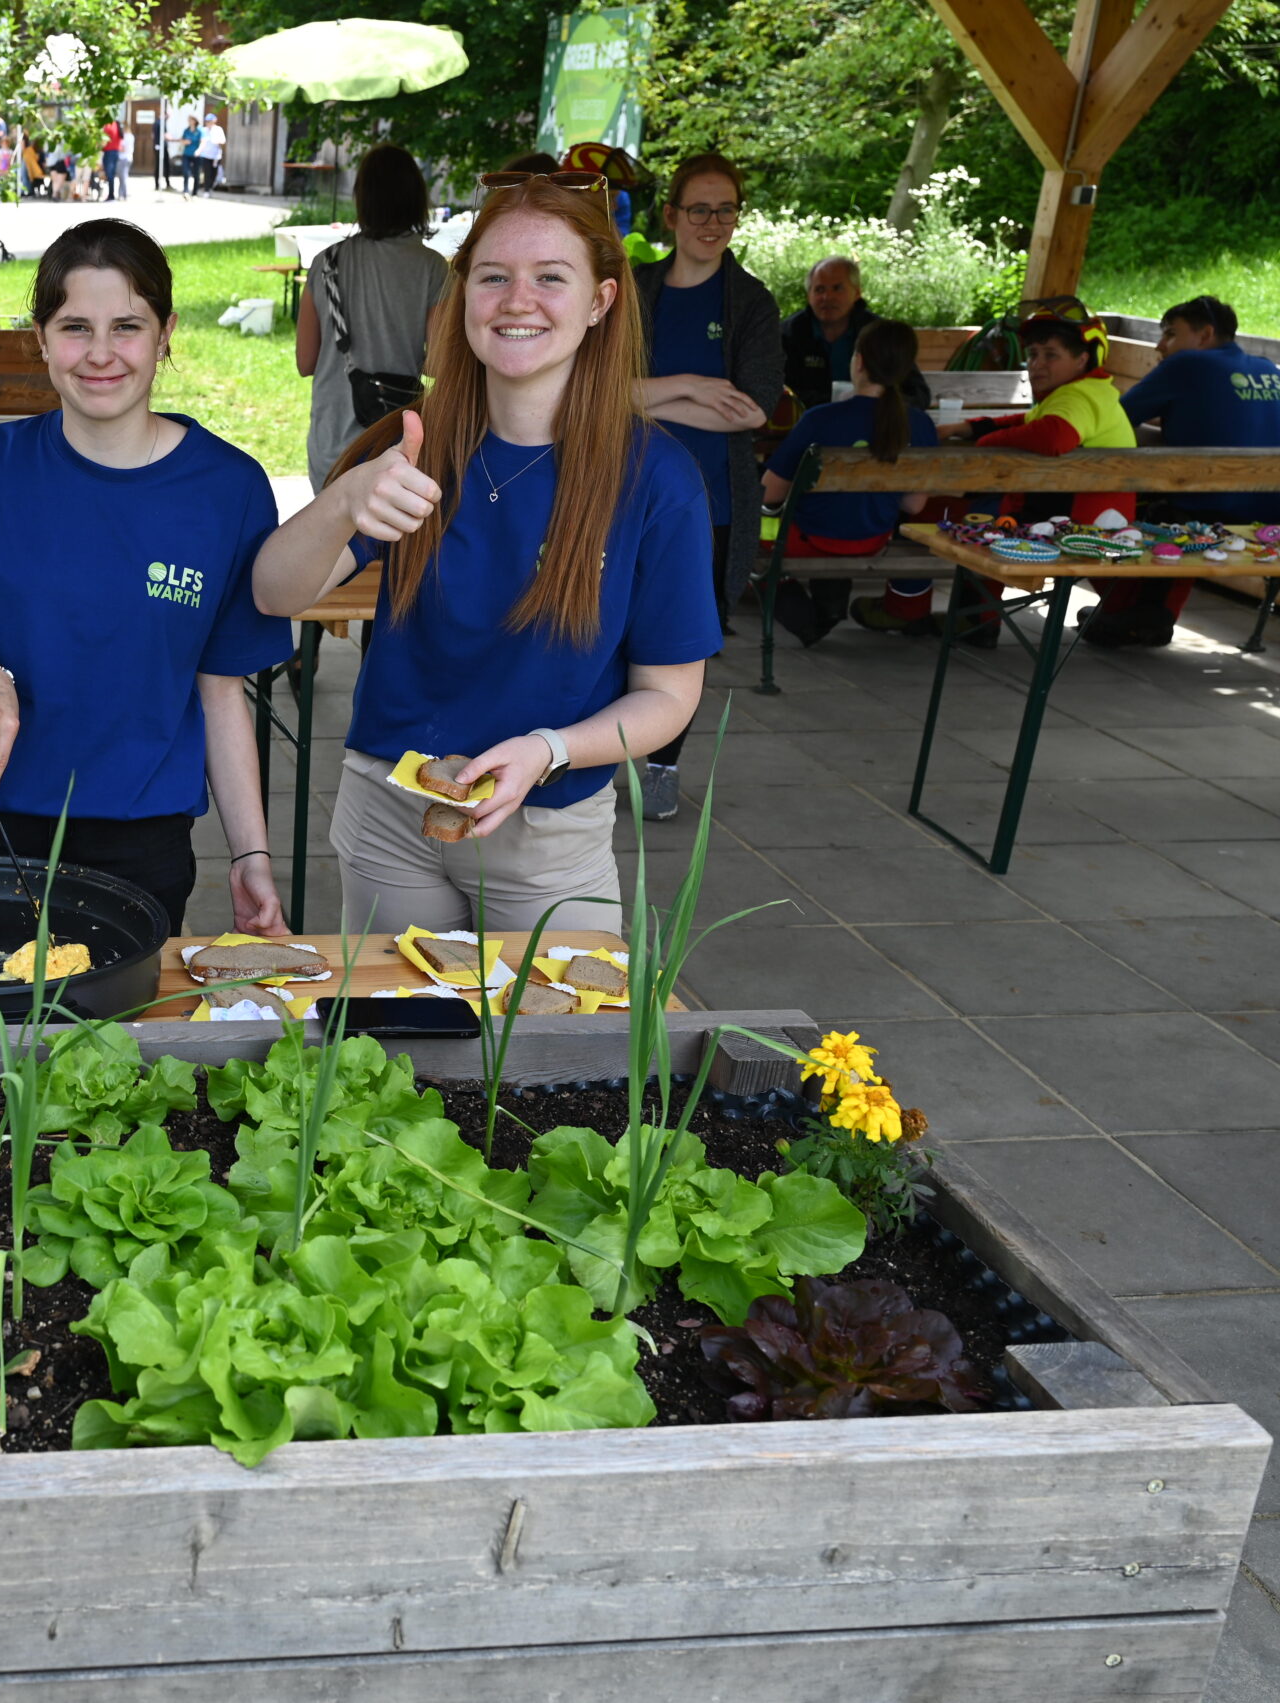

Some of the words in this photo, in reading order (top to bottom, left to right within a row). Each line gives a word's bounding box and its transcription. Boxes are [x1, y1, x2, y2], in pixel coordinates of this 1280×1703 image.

[1234, 388, 1280, 401] WART
[168, 564, 204, 592] LFS
[146, 581, 201, 608] WARTH
